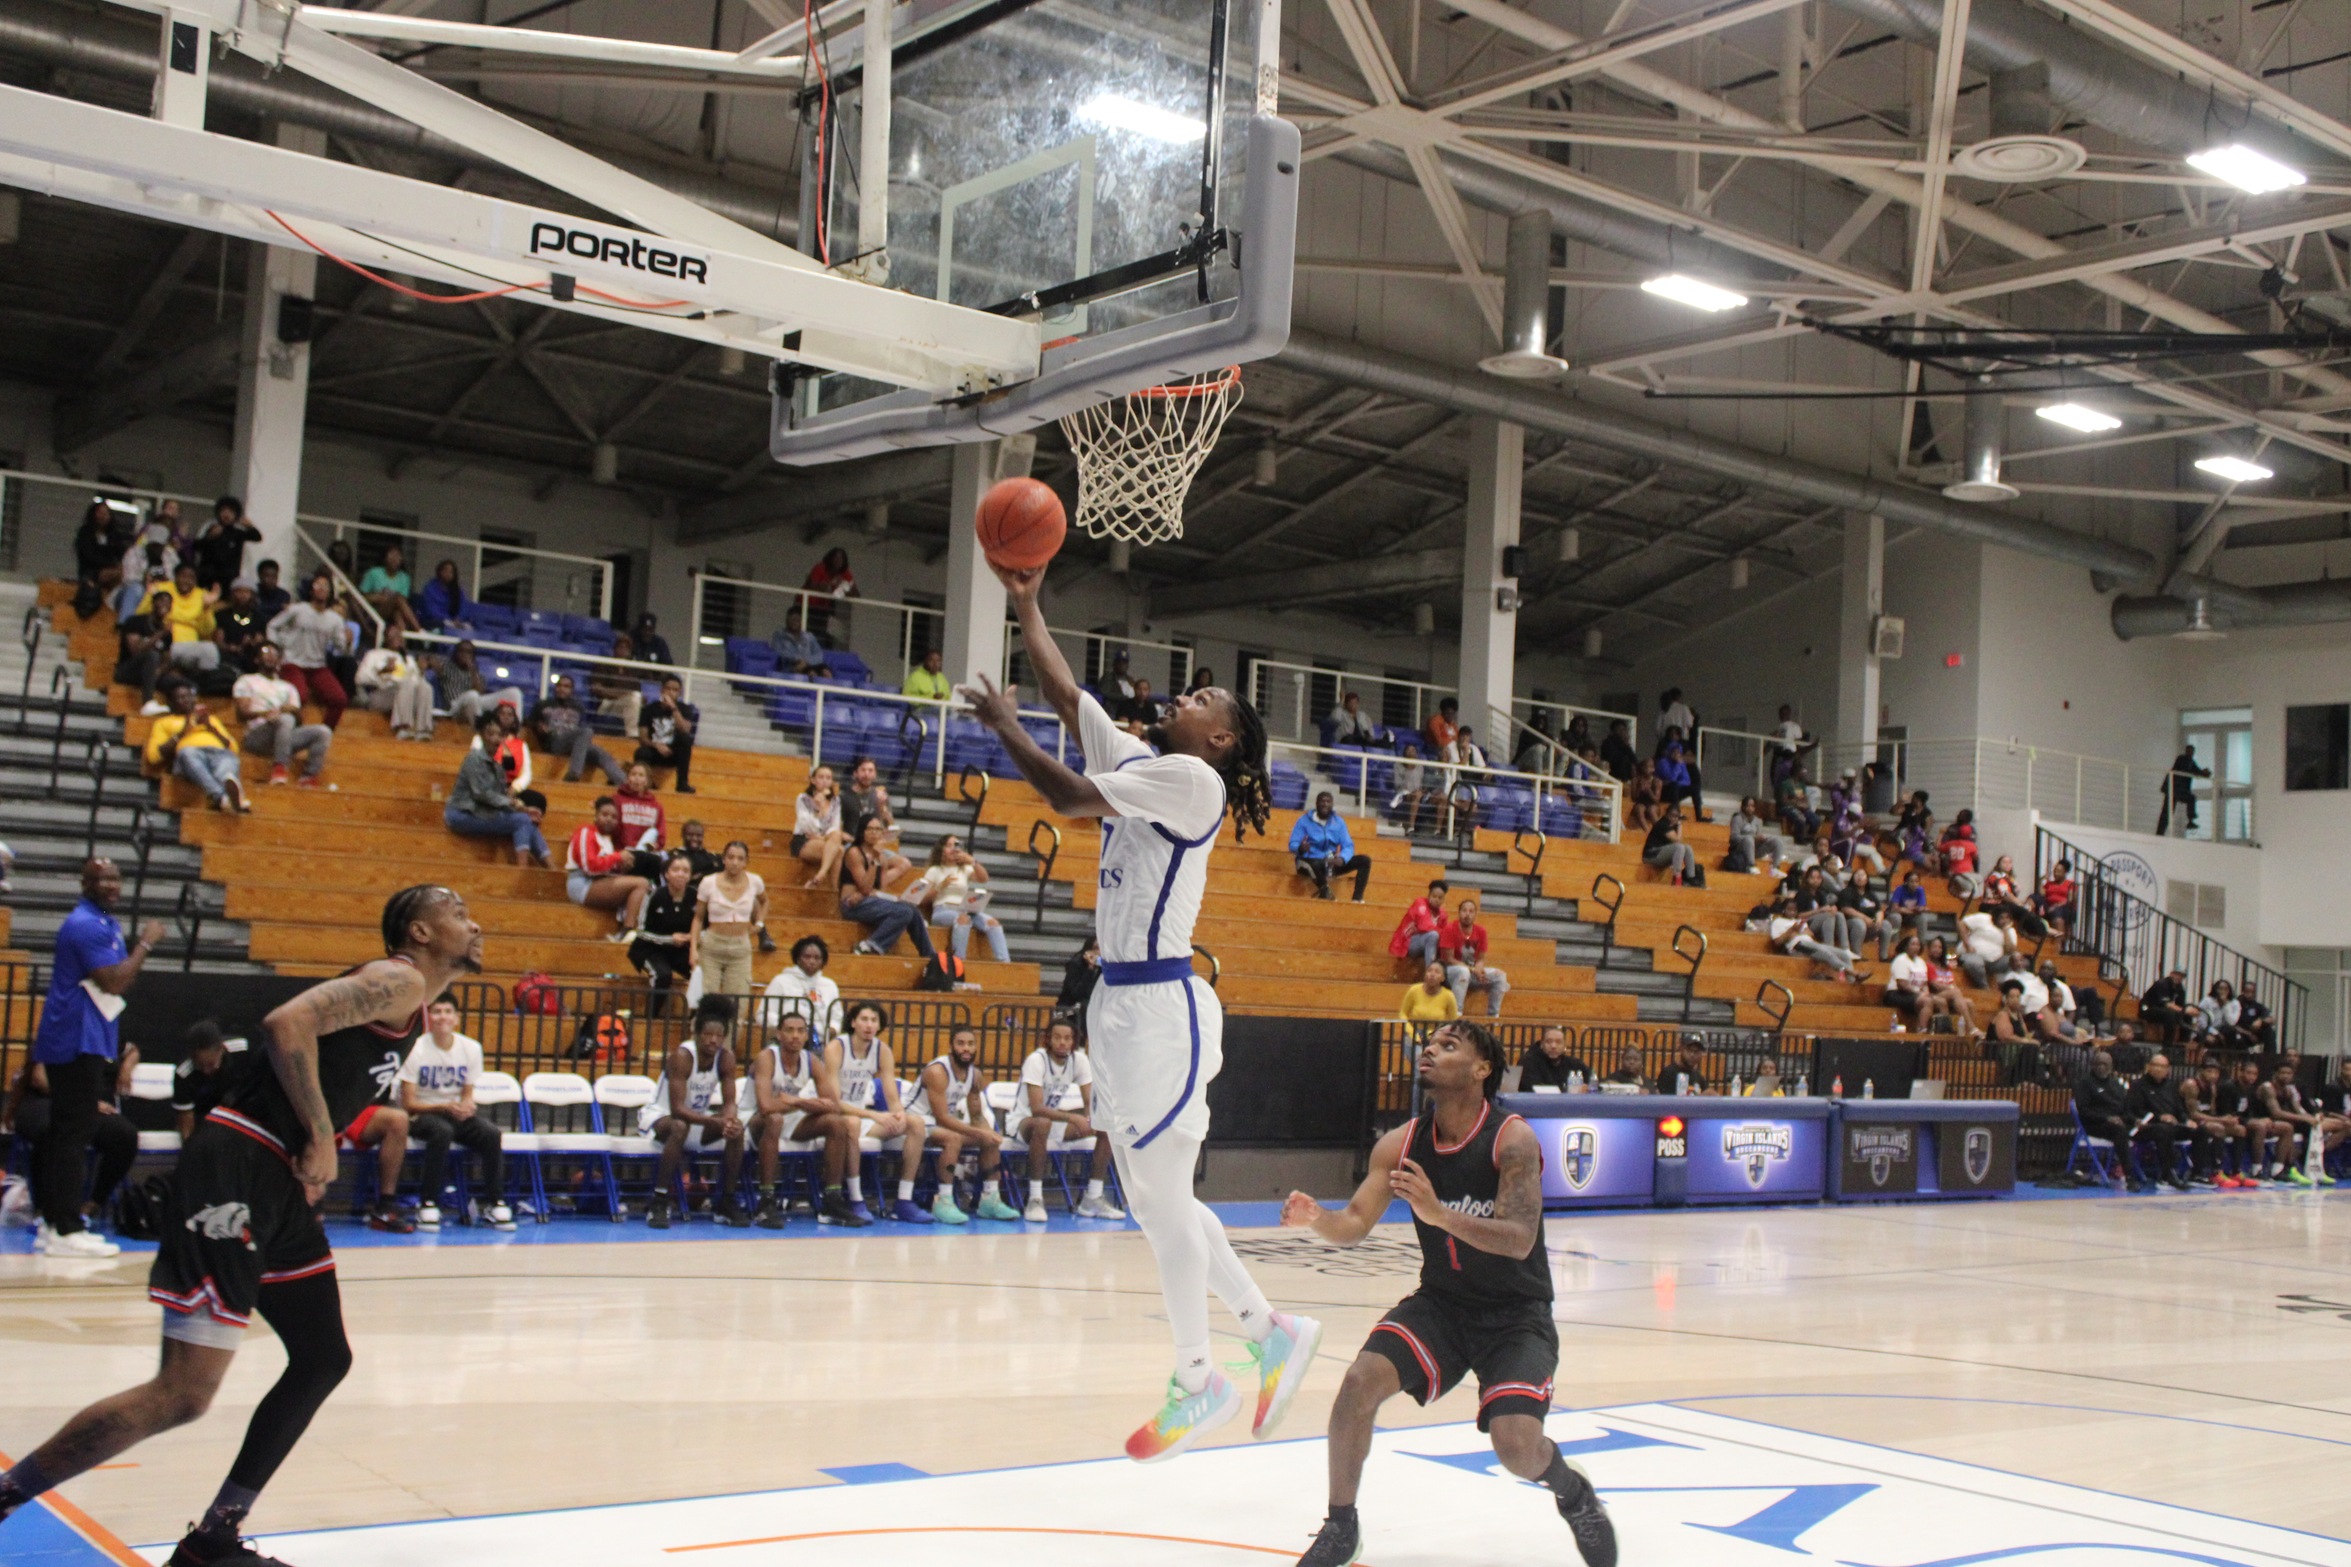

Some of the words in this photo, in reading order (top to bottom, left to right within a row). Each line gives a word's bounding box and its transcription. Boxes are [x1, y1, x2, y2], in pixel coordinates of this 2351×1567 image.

[1657, 1138, 1685, 1156] POSS
[1725, 1130, 1753, 1150] VIRGIN
[1754, 1129, 1788, 1150] ISLANDS
